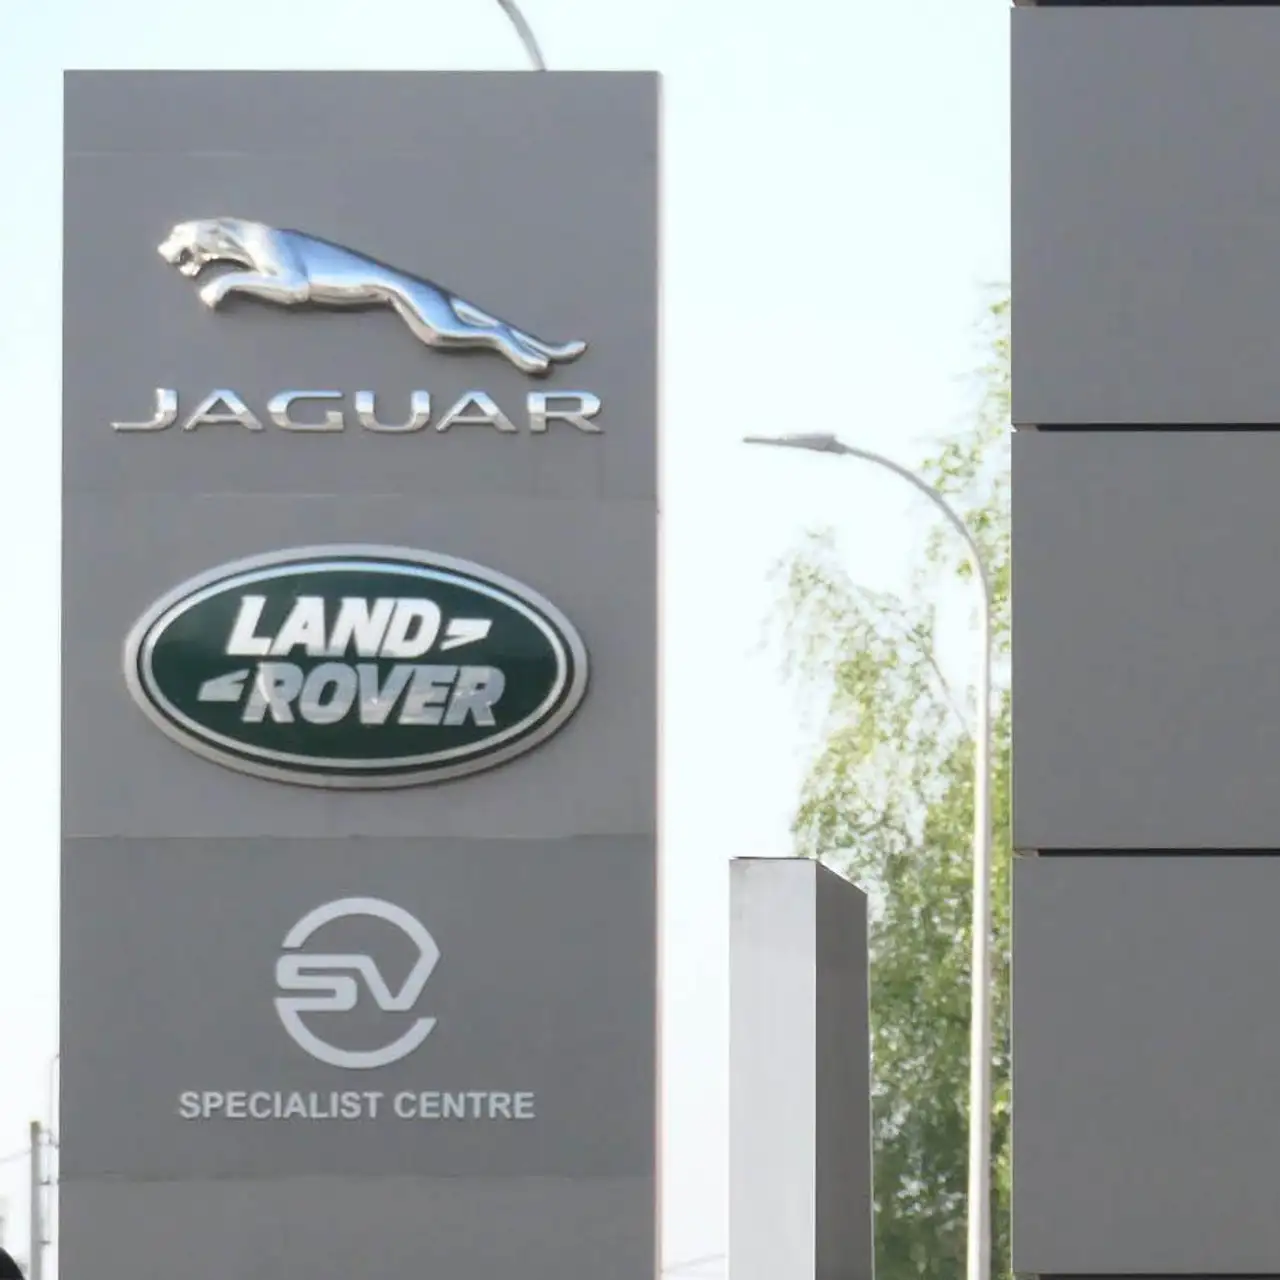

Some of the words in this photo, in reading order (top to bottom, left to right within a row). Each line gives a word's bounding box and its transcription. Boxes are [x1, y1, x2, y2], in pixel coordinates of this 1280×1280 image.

[110, 387, 604, 433] JAGUAR
[226, 595, 442, 658] LAND
[242, 662, 506, 726] ROVER
[178, 1090, 384, 1120] SPECIALIST
[392, 1090, 535, 1120] CENTRE
